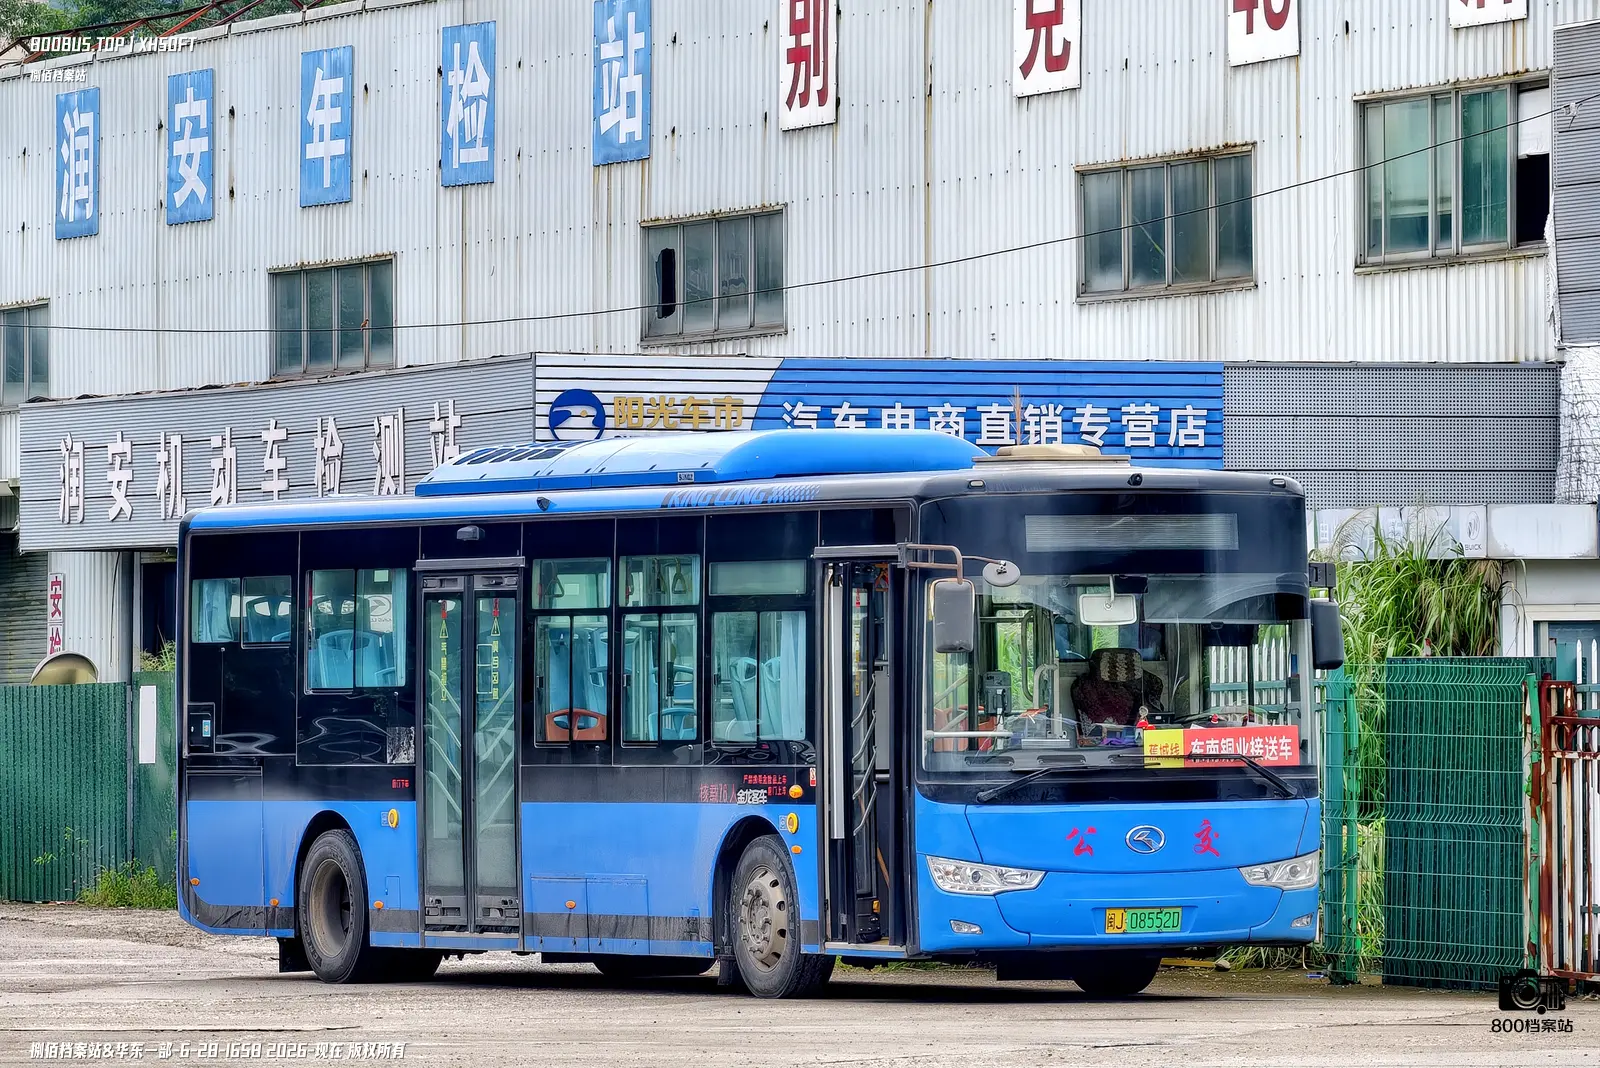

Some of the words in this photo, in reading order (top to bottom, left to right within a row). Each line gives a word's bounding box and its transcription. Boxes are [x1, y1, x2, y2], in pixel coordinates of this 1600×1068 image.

[613, 396, 744, 430] 阳光车市
[782, 401, 1208, 447] 汽车电商直销专营店
[59, 399, 462, 524] 润安机动车检测站
[1464, 543, 1482, 551] BUICK
[737, 788, 768, 805] 金龙客车
